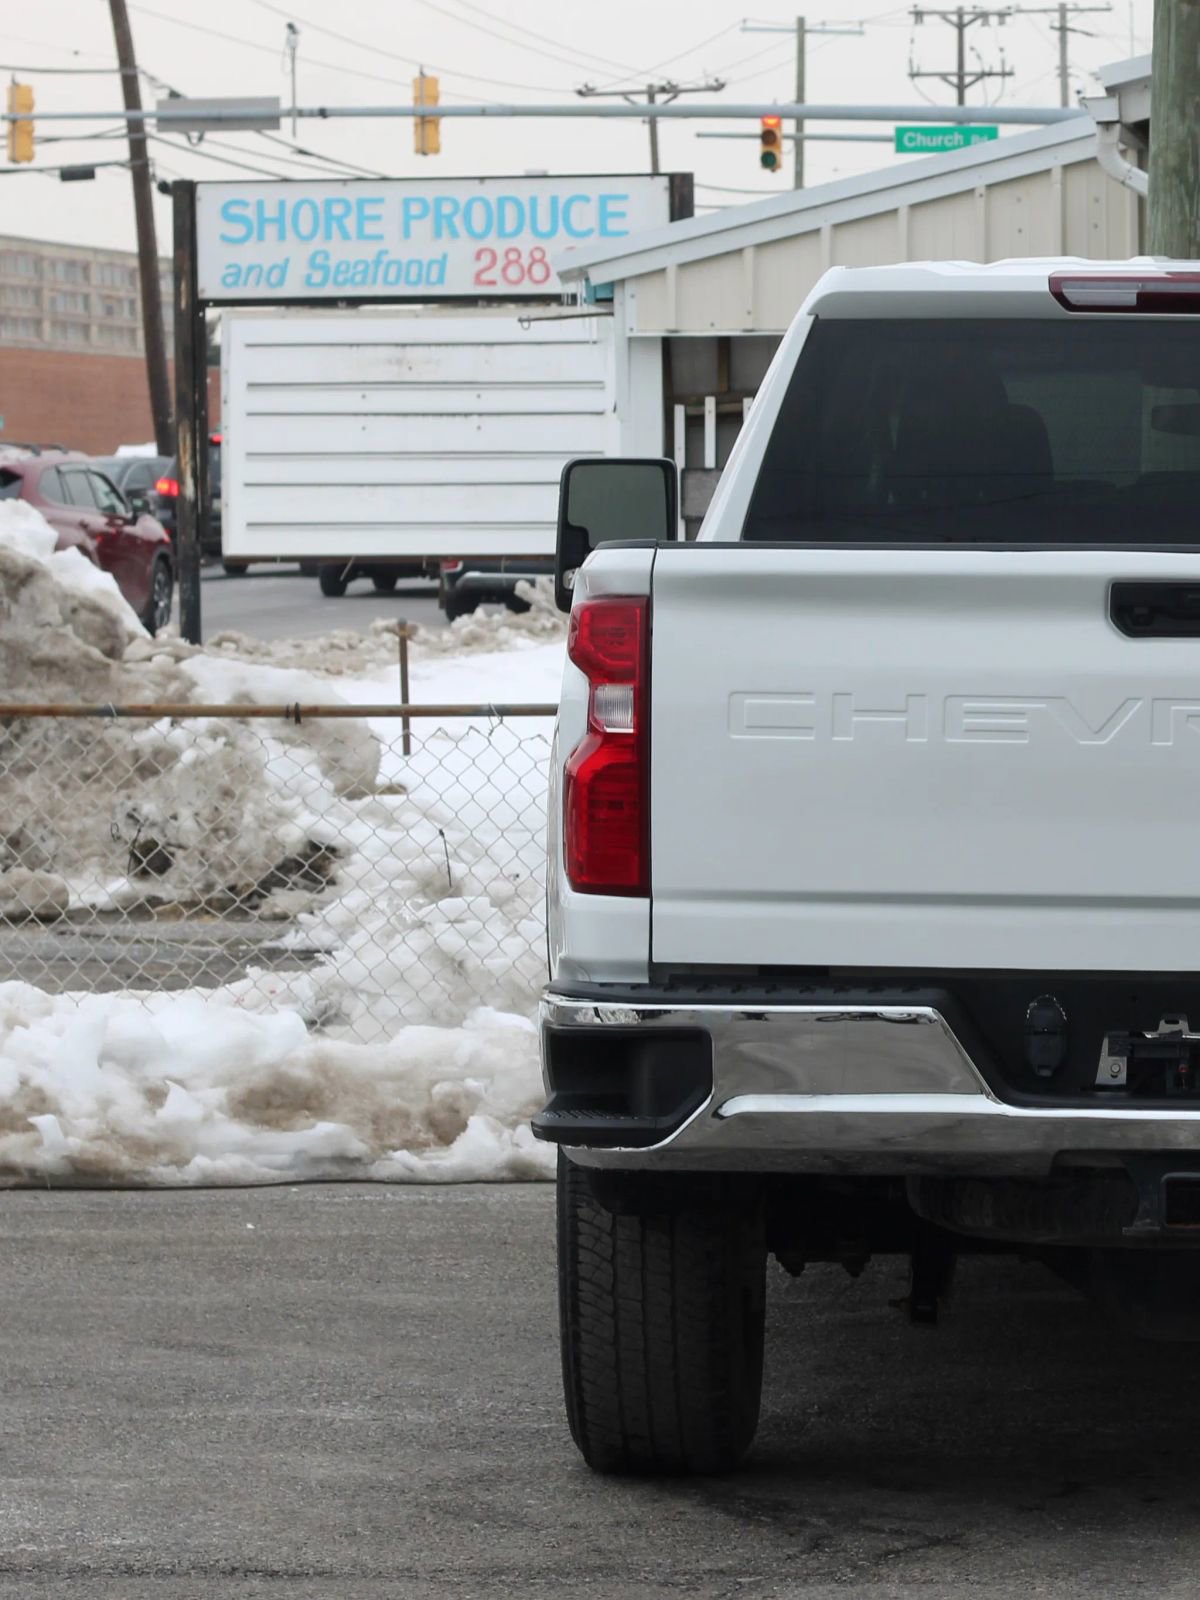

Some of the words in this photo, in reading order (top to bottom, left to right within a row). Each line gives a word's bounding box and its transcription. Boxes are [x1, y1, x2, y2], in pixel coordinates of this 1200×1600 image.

[903, 131, 964, 148] Church
[219, 197, 385, 245] SHORE
[402, 194, 630, 240] PRODUCE
[221, 257, 290, 289] and
[304, 248, 448, 289] Seafood
[473, 246, 551, 286] 288
